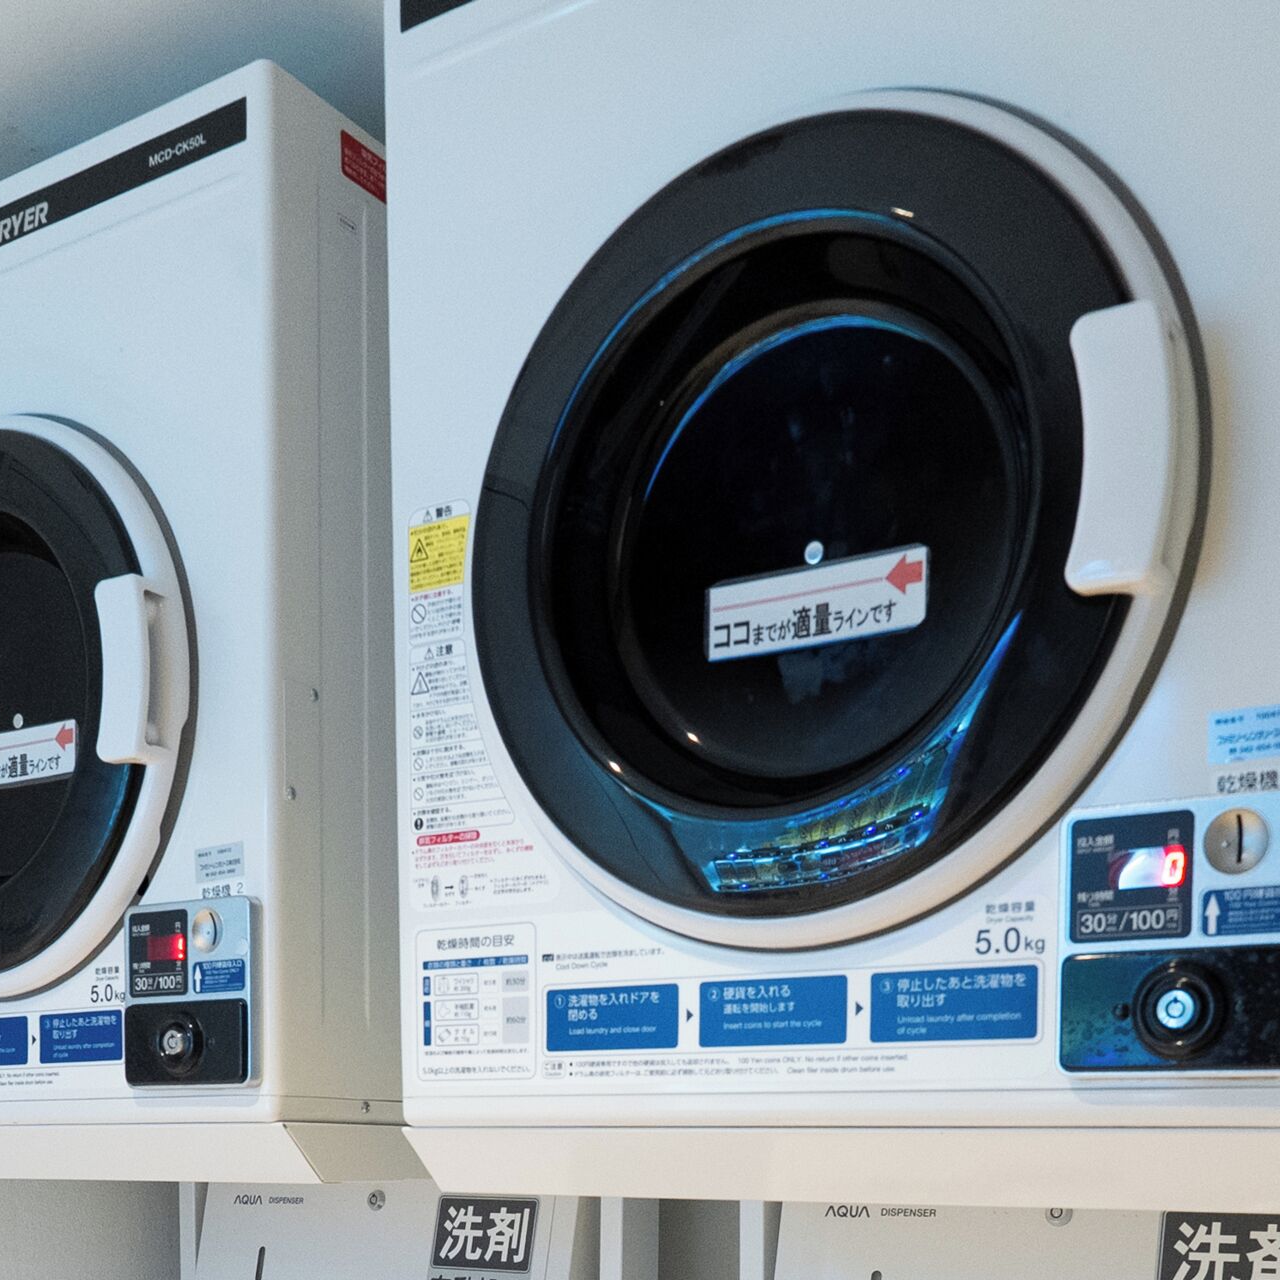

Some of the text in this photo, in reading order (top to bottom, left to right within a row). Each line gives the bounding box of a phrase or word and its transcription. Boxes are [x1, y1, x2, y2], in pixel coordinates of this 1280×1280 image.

[149, 132, 207, 168] MCD-CK50L
[713, 599, 897, 649] ココまでが適量ラインです
[1217, 770, 1279, 794] 乾燥機
[1162, 851, 1185, 886] 0
[437, 935, 515, 951] 乾燥時間の目安
[897, 973, 1026, 992] 停止したあと洗濯物を
[568, 992, 660, 1008] 洗濯物を入れドアを
[723, 985, 791, 1000] 硬貨を入れる
[897, 993, 947, 1008] 取り出す
[568, 1009, 598, 1021] 閉める
[803, 1019, 822, 1028] cycle
[233, 1194, 304, 1205] AQUA DISPENSER
[824, 1205, 936, 1218] AQUA DISPENSER
[440, 1206, 530, 1263] 洗剤
